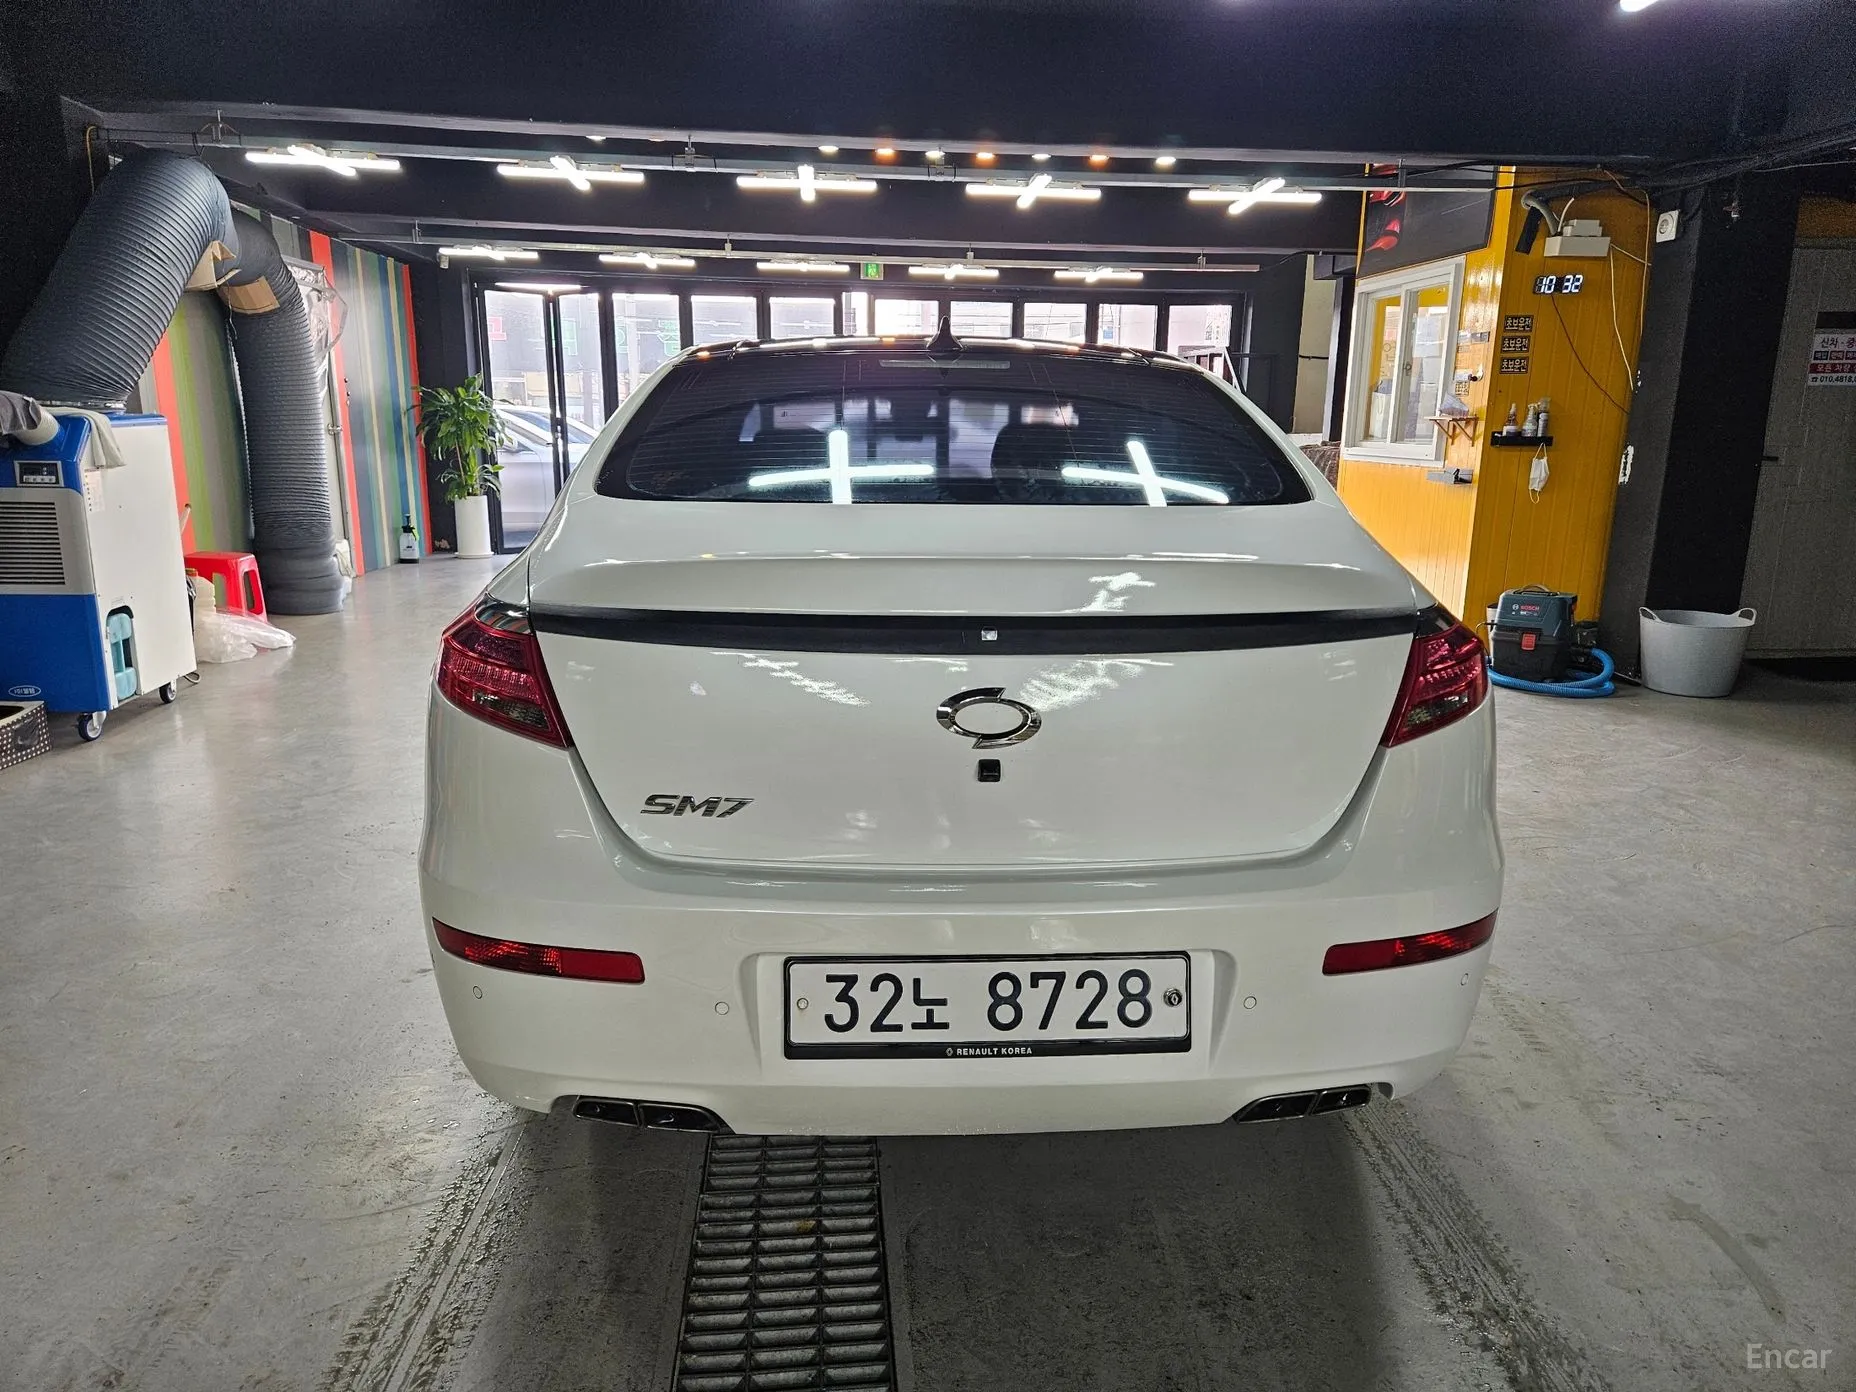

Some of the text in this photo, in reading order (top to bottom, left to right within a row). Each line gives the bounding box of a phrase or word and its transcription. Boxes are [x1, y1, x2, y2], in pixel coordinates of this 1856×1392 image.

[1505, 317, 1532, 331] 초보운전
[1502, 337, 1529, 351] 초보운전
[1501, 358, 1528, 372] 초보운전
[640, 794, 755, 818] SM7
[824, 968, 1153, 1033] 32노 8728
[956, 1046, 1033, 1056] RENAULT KOREA
